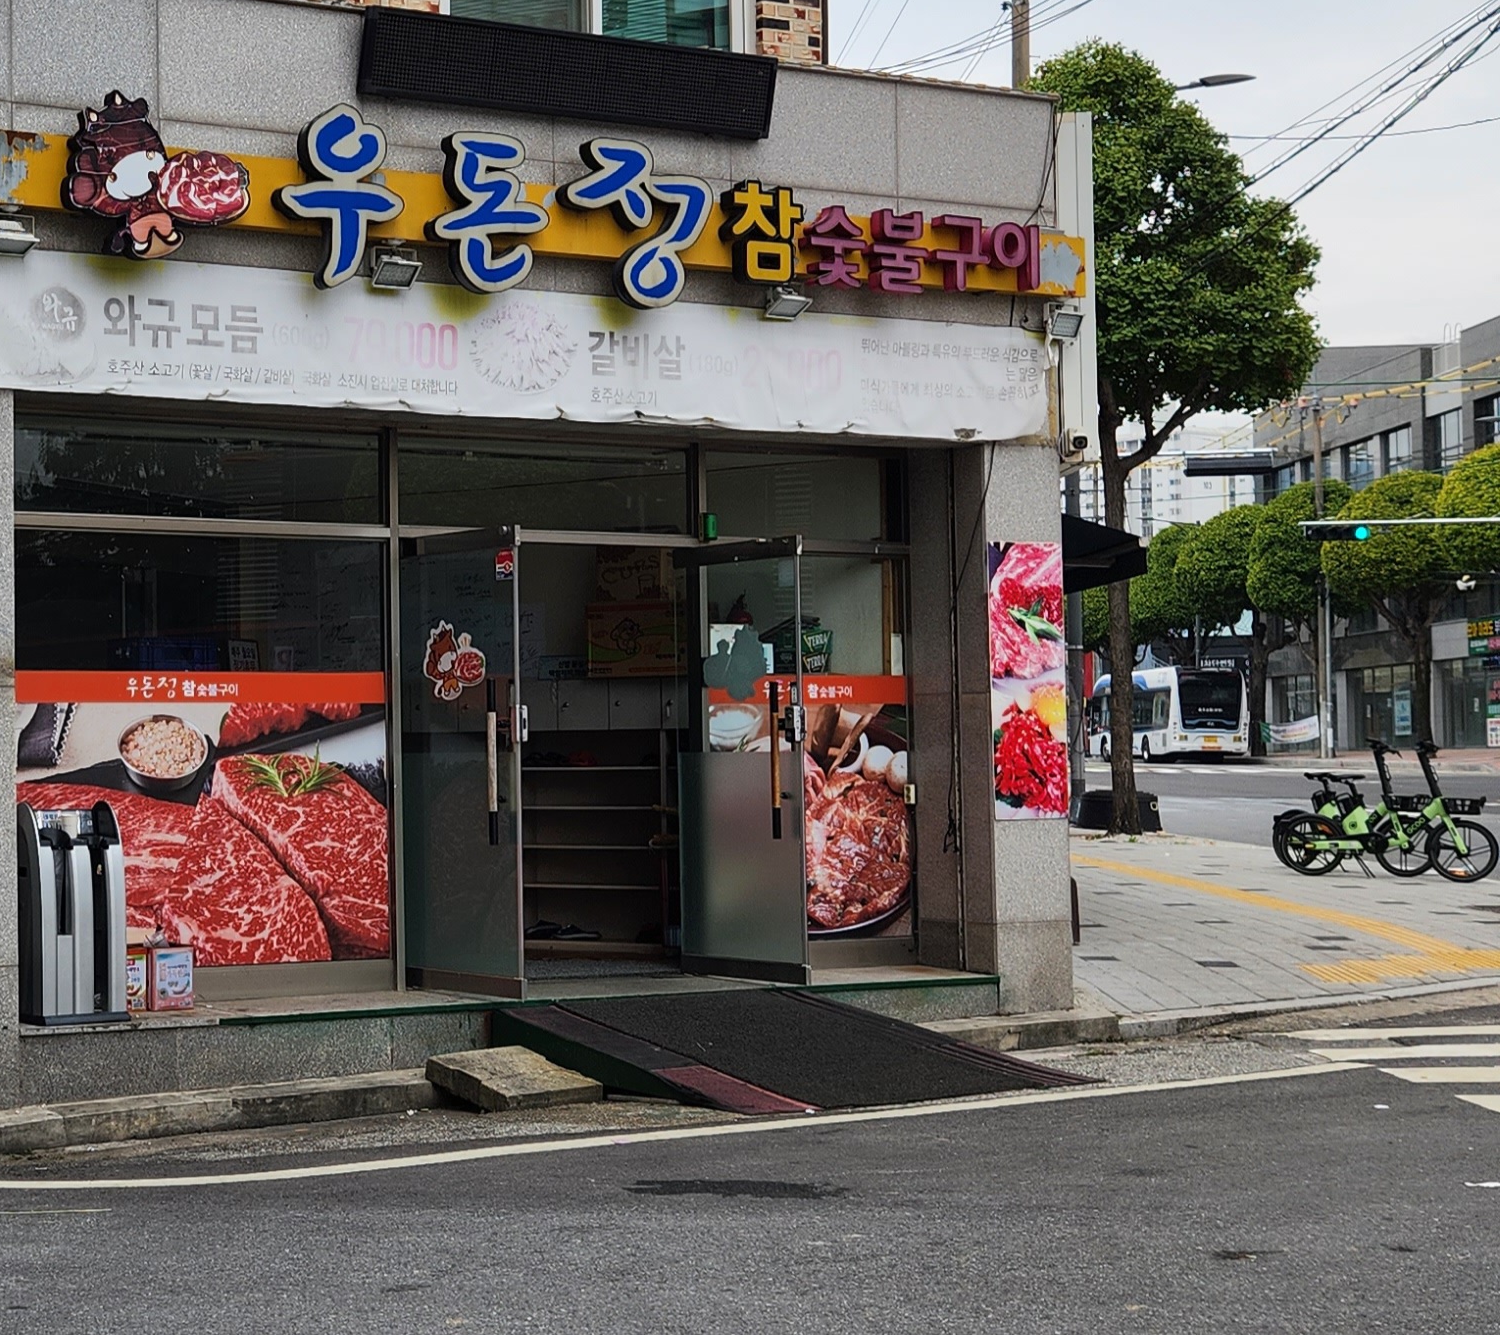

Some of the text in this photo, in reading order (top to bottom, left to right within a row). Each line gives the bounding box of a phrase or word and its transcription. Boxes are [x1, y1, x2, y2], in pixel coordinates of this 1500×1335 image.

[276, 103, 1041, 309] 우돈정 참숯불구이
[103, 295, 181, 349] 와규
[186, 303, 264, 355] 모듬
[588, 330, 686, 381] 갈비살
[861, 338, 1039, 363] 뛰어난 마블링과 특유의 부드러운 식감으로
[107, 358, 144, 376] 호주산
[150, 363, 184, 379] 소고기
[189, 363, 213, 381] (꽃살
[223, 366, 253, 382] 국화살
[264, 368, 295, 385] 갈비살)
[302, 370, 332, 386] 국화살
[337, 373, 367, 390] 소진시
[590, 385, 658, 408] 호주산 소고기
[808, 633, 830, 645] TERRA
[806, 655, 828, 667] TERRA
[125, 676, 240, 699] 우돈정 참숯불구이
[807, 684, 853, 699] 참숯불구이
[1406, 817, 1426, 834] GCOO
